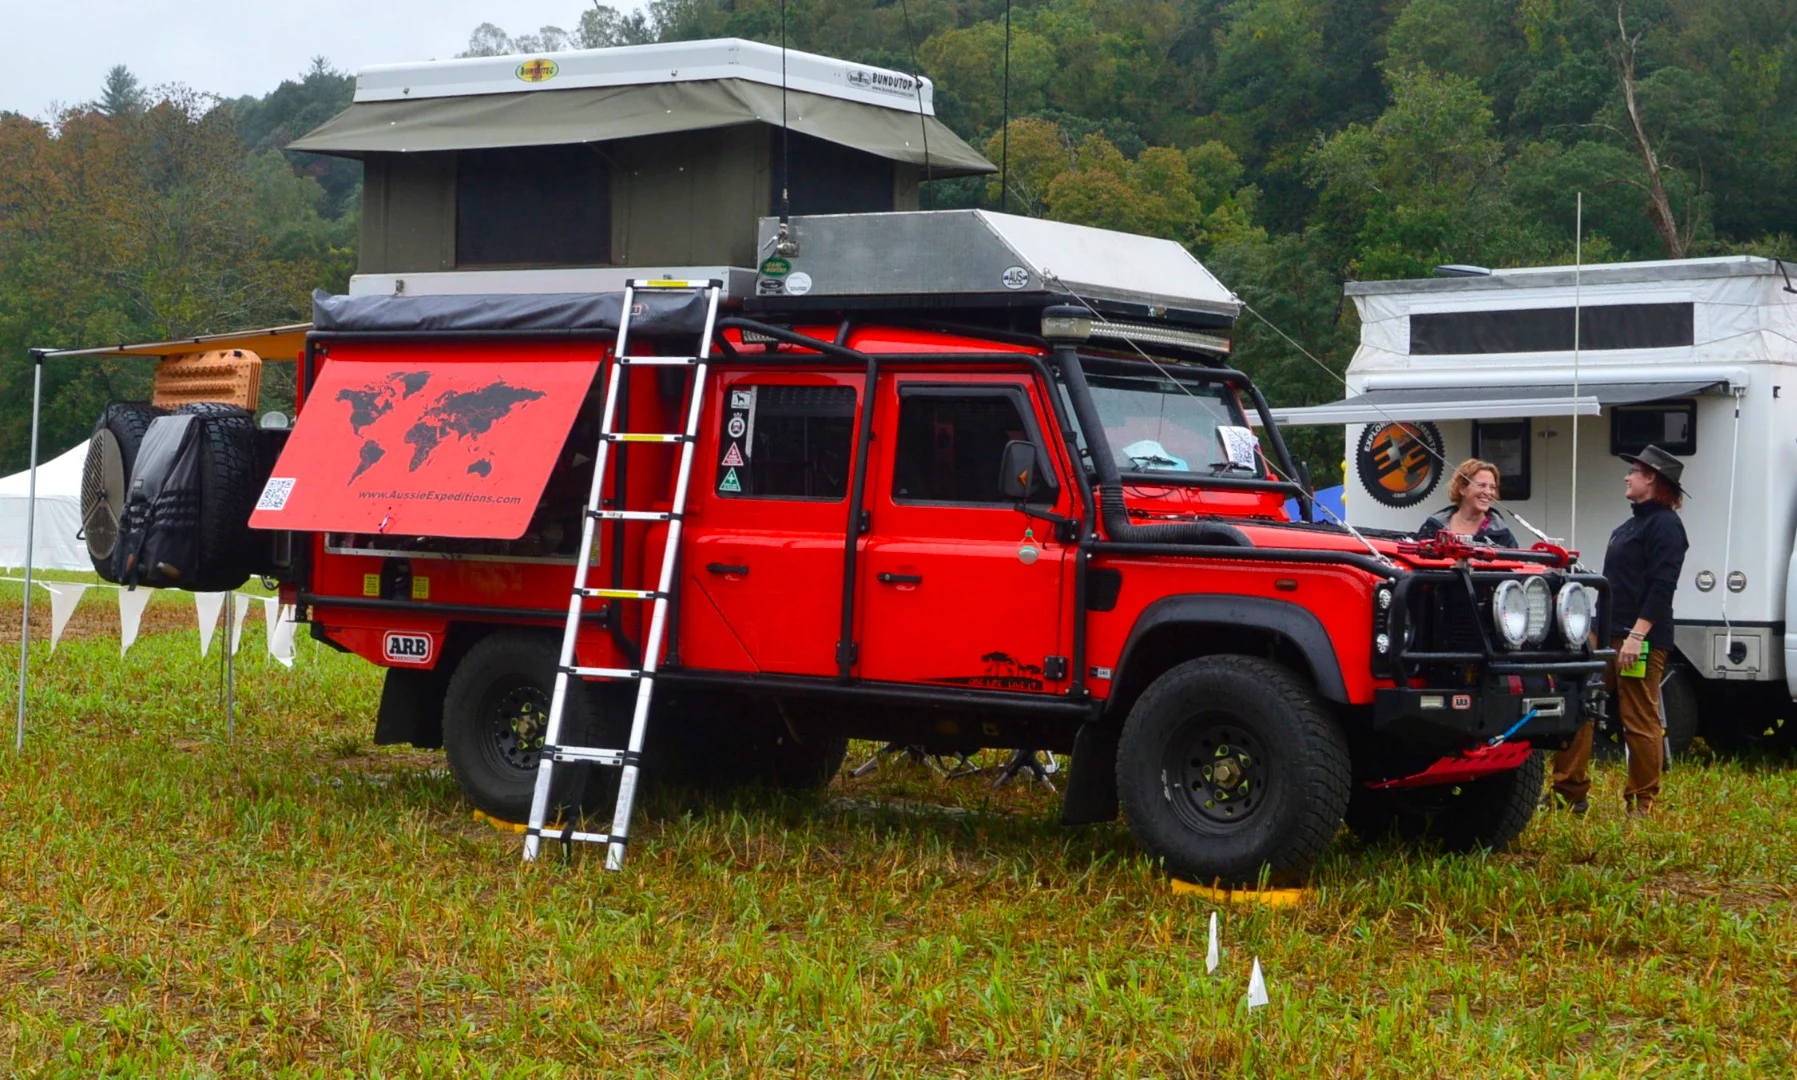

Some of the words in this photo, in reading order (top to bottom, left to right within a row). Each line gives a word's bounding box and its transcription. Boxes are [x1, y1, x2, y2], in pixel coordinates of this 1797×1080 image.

[872, 72, 913, 90] BUNDUTOP
[358, 490, 521, 505] www.AussieExpeditions.com
[389, 637, 426, 656] ARB
